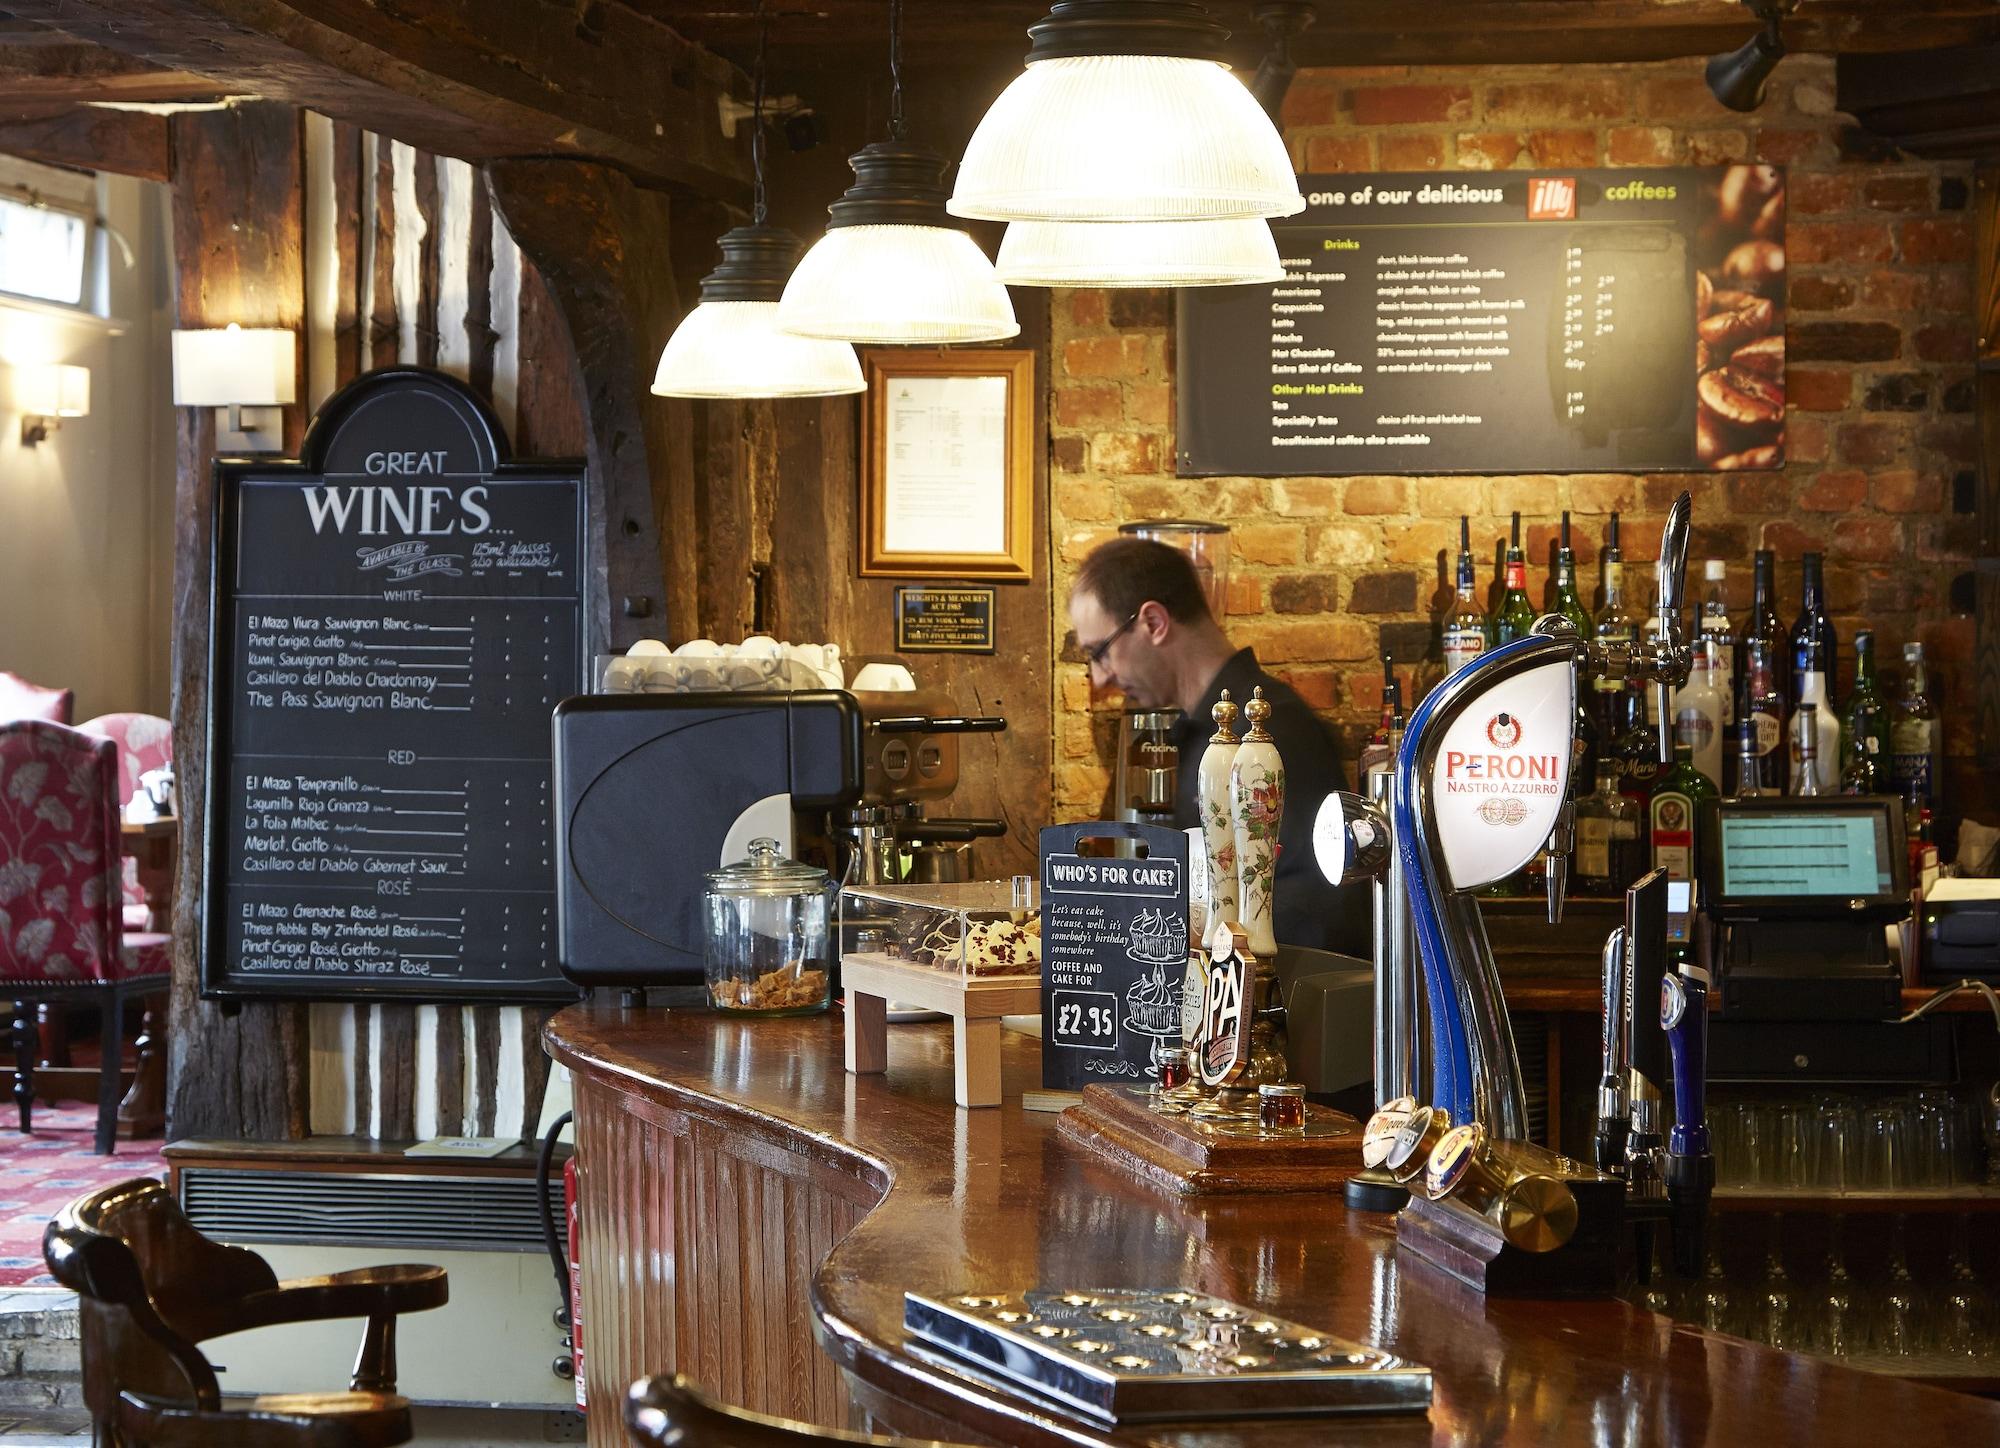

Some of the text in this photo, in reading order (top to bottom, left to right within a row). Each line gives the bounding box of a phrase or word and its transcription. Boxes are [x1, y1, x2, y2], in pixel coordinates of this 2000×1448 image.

[1308, 181, 1677, 217] one of our delicious illy coffees
[1324, 239, 1360, 249] Drinks
[1306, 272, 1346, 283] Espresso
[1384, 271, 1409, 280] double
[1410, 271, 1425, 279] shot
[1426, 270, 1434, 279] of
[1435, 270, 1460, 279] intense
[1461, 269, 1481, 279] black
[1482, 269, 1505, 278] coffee
[1272, 288, 1321, 297] Americano
[1272, 303, 1324, 314] Cappuccino
[1272, 318, 1295, 327] Latte
[1272, 334, 1303, 343] Mocha
[1272, 349, 1335, 358] Hot Chocolate
[1272, 363, 1362, 373] Extra Shot of Coffee
[1272, 383, 1364, 394] Other Hot Drinks
[1272, 401, 1288, 410] Tea
[1318, 416, 1338, 425] Teas
[1377, 416, 1401, 424] choice
[1402, 415, 1410, 424] of
[1411, 415, 1425, 424] fruit
[1426, 415, 1440, 424] and
[1442, 415, 1465, 424] herbal
[1336, 436, 1364, 445] coffee
[1365, 435, 1385, 444] also
[1387, 434, 1430, 444] available
[365, 451, 448, 475] GREAT
[362, 544, 429, 566] AVAILABLE BY
[510, 540, 551, 556] glasses
[395, 557, 451, 577] THE GLASS
[471, 555, 493, 567] also
[383, 590, 423, 601] WHITE
[248, 616, 257, 629] El
[262, 618, 288, 628] Mazo
[293, 616, 318, 629] Viura
[325, 617, 378, 633] Sauvignon
[383, 617, 410, 630] Blanc
[249, 634, 276, 647] Pinot
[313, 635, 344, 648] Giotto
[279, 653, 333, 668] Sauvignon
[338, 653, 368, 666] Blanc
[247, 670, 436, 692] Casillero del Diablo Chardonnay
[247, 691, 433, 712] The Pass Sauvignon Blanc
[388, 749, 415, 765] RED
[1446, 751, 1559, 781] PERONI
[246, 776, 258, 789] El
[263, 777, 291, 790] Mazo
[295, 776, 358, 794] Tempranillo
[1447, 781, 1558, 795] NASTRO AZZURRO
[246, 796, 369, 815] Lagunilla Rioja Crianza
[245, 815, 258, 829] La
[264, 815, 287, 829] Folia
[291, 817, 329, 831] Malbec
[292, 837, 328, 851] Giotto
[243, 857, 294, 871] Casillero
[298, 857, 315, 871] del
[320, 858, 358, 872] Diablo
[363, 858, 415, 873] Cabernet
[1053, 864, 1175, 886] WHO'S FOR CAKE?
[377, 877, 412, 895] ROSÉ
[242, 903, 253, 916] El
[258, 904, 288, 917] Mazo
[293, 903, 345, 918] Grenache
[350, 905, 377, 919] Rosé
[1051, 904, 1068, 914] Let's
[1086, 905, 1104, 916] cake
[243, 922, 418, 939] Three Pebble Bay Zinfandel Rosé
[1051, 917, 1121, 930] because, well, it's
[1051, 931, 1129, 947] somebody's birthday
[242, 939, 271, 953] Pinot
[272, 939, 305, 957] Grigio
[342, 943, 380, 956] Giotto
[1051, 945, 1094, 956] somewhere
[241, 956, 430, 976] Casillero del Diablo Shiraz Rosé
[1052, 961, 1102, 974] COFFEE AND
[1051, 974, 1092, 986] CAKE FOR
[1203, 960, 1240, 1044] IPA
